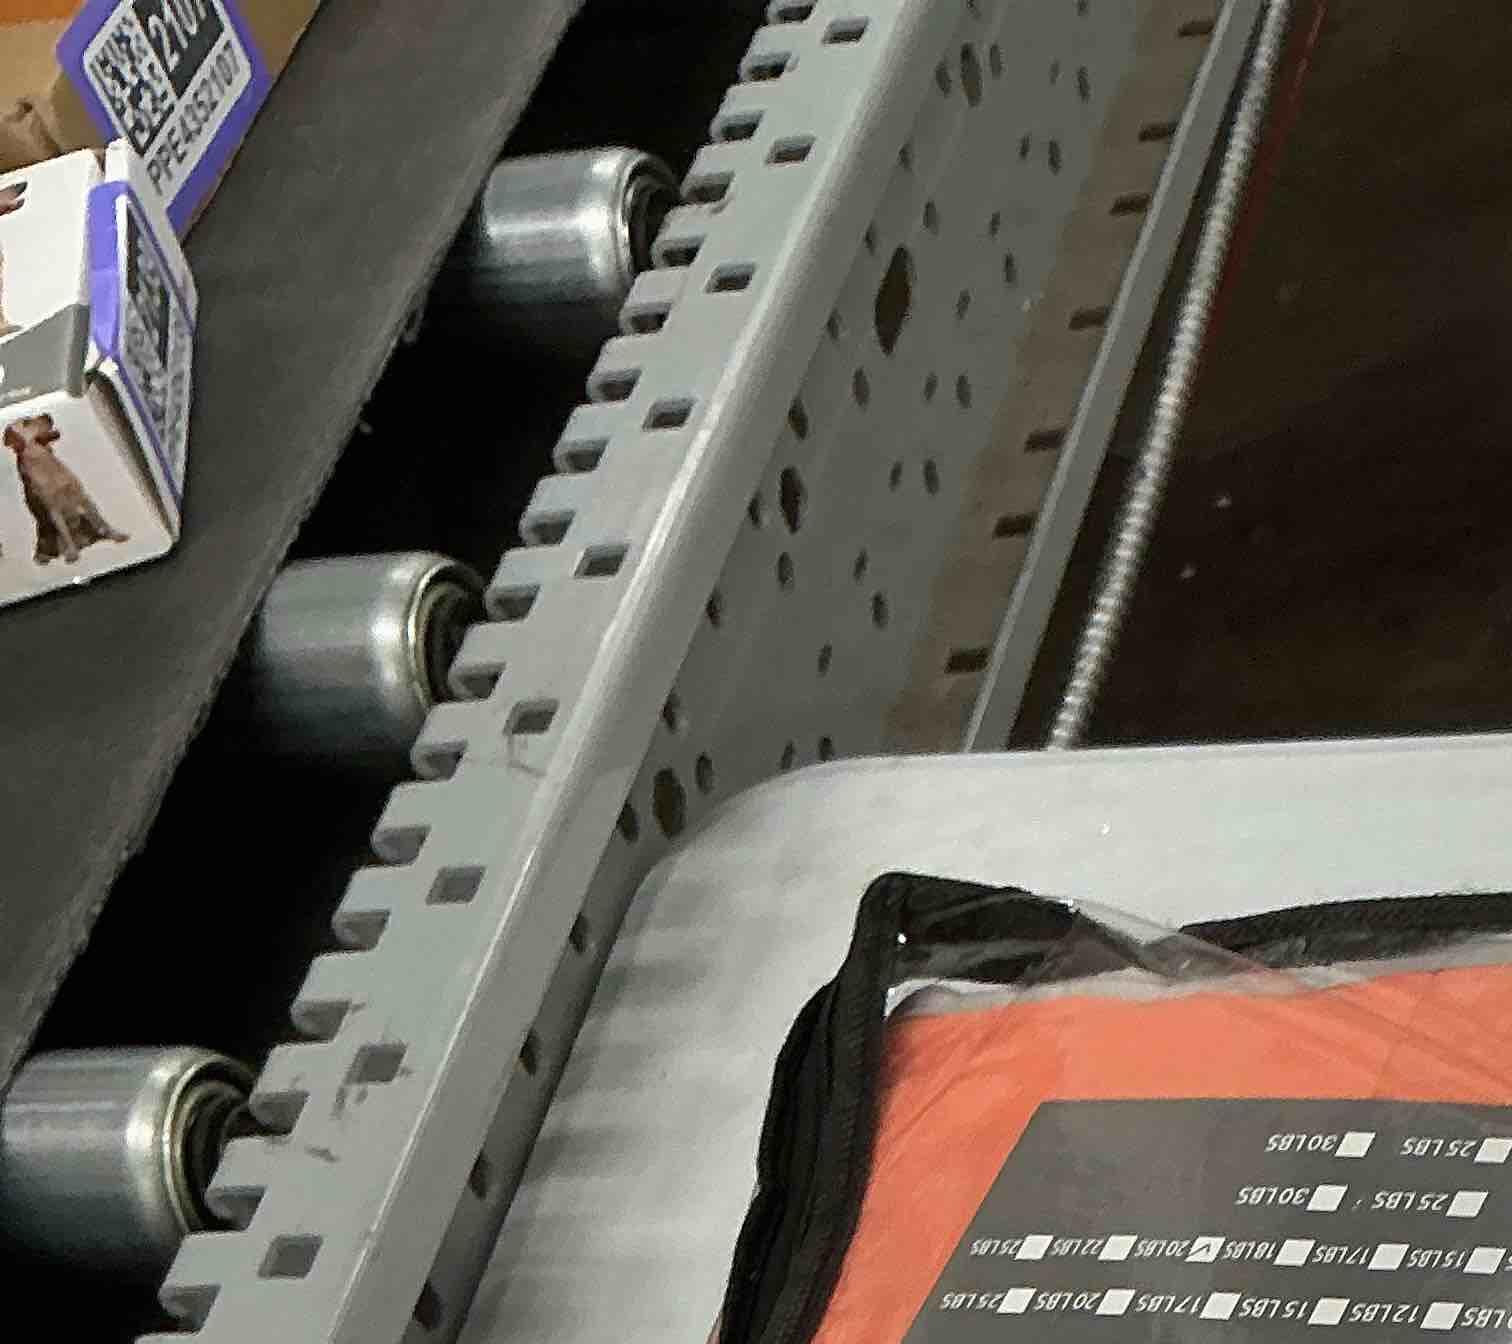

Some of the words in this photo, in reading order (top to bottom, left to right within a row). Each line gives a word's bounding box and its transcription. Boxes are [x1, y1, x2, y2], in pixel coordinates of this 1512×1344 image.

[1263, 1131, 1307, 1152] LBS
[1399, 1137, 1444, 1156] LBS
[1444, 1139, 1477, 1156] 25
[1233, 1185, 1278, 1205] LBS
[1277, 1186, 1309, 1205] 30
[1370, 1190, 1416, 1210] LBS
[1416, 1192, 1449, 1210] 25
[1032, 1291, 1073, 1310] LBS
[1134, 1293, 1176, 1313] LBS
[1237, 1296, 1281, 1318] LBS
[1347, 1302, 1393, 1322] LBS
[1459, 1306, 1506, 1329] LBS
